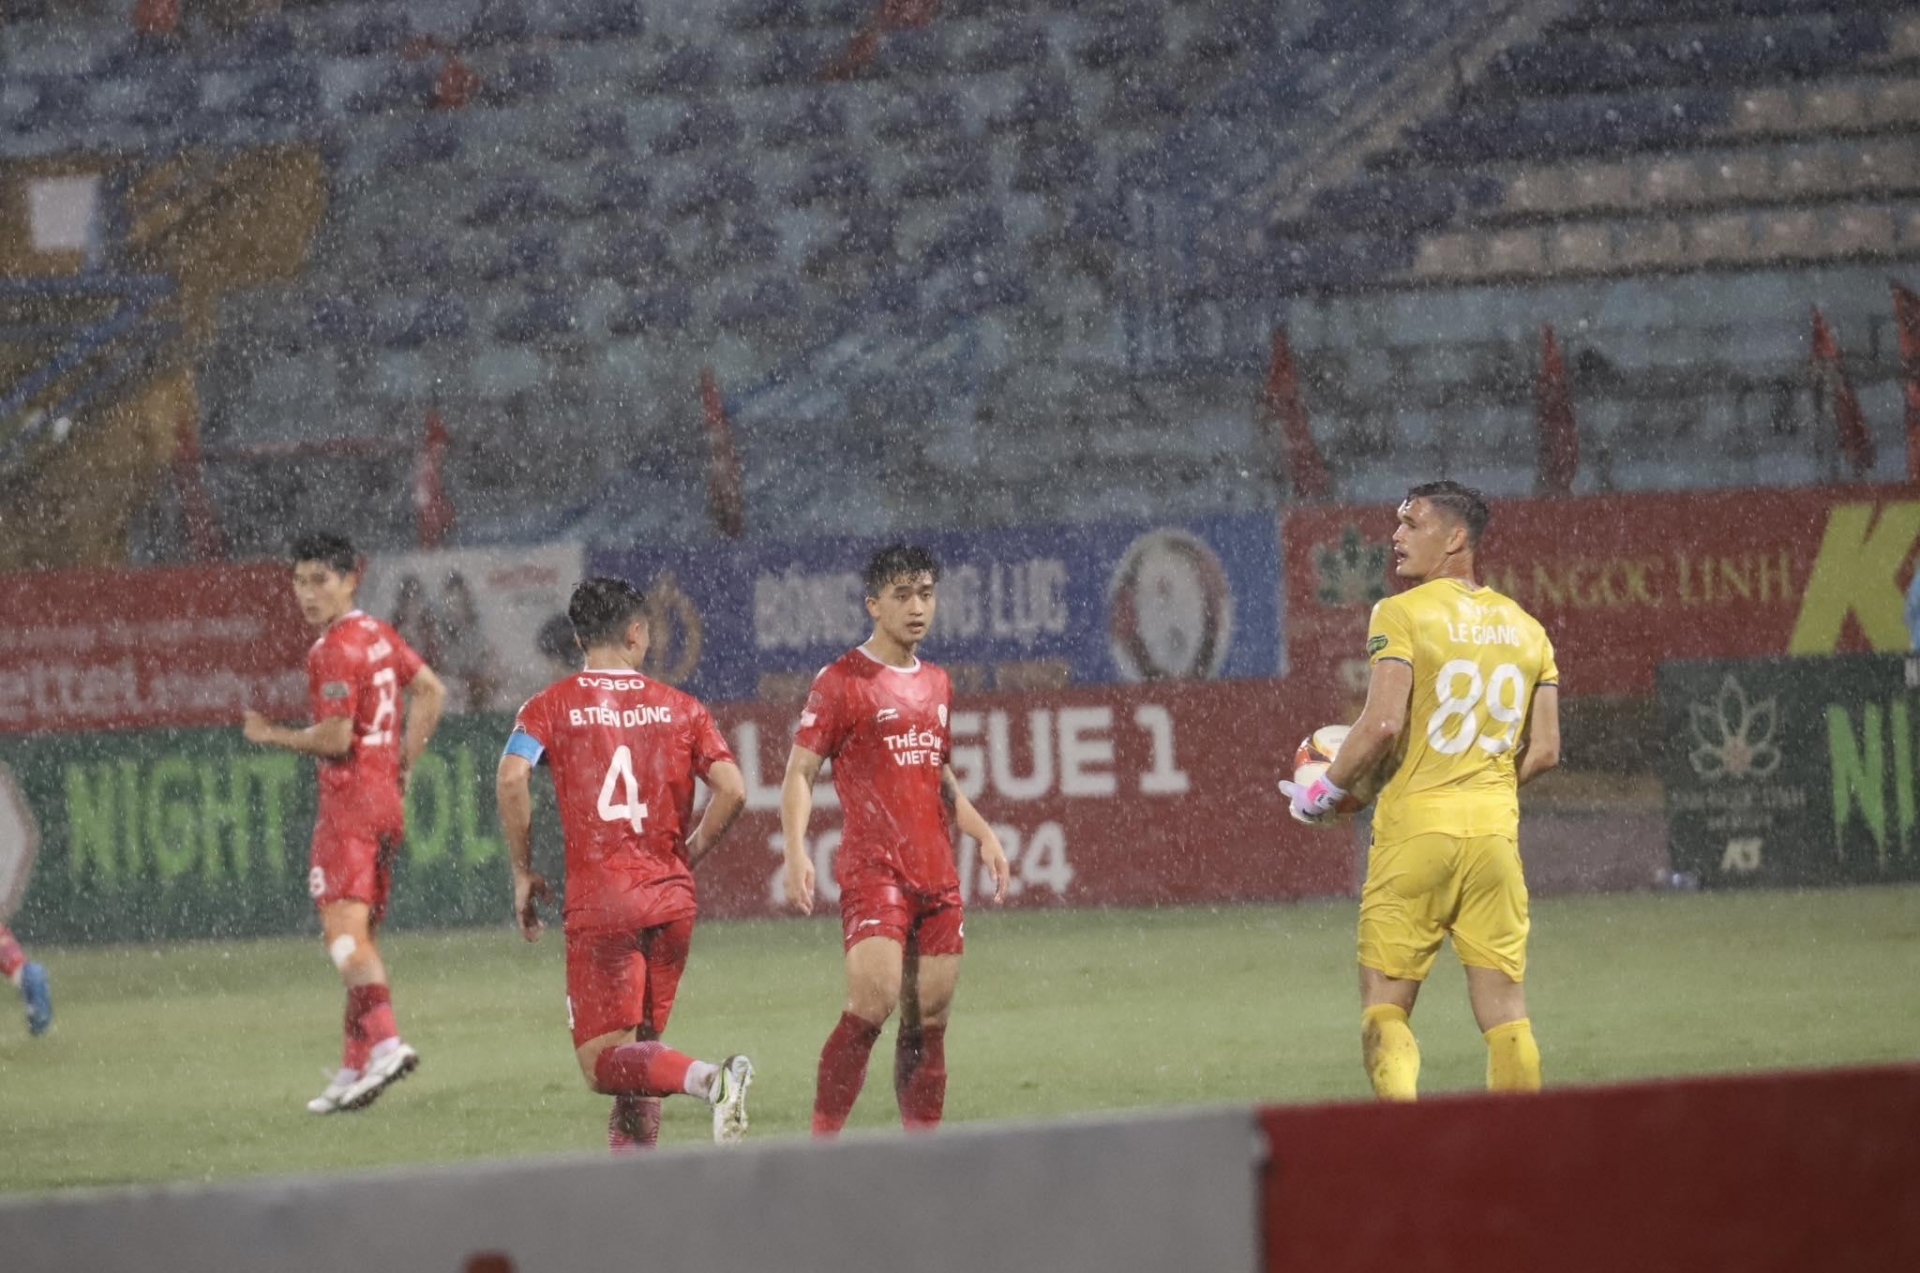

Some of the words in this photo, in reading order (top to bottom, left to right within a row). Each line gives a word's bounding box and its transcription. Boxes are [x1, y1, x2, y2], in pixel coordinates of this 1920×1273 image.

[569, 699, 621, 728] B.TIẾN
[622, 704, 672, 728] DŨNG
[578, 676, 645, 691] tv360
[1427, 658, 1525, 756] 89
[597, 744, 649, 834] 4
[1136, 703, 1192, 795] 1
[65, 754, 298, 882] NIGHT
